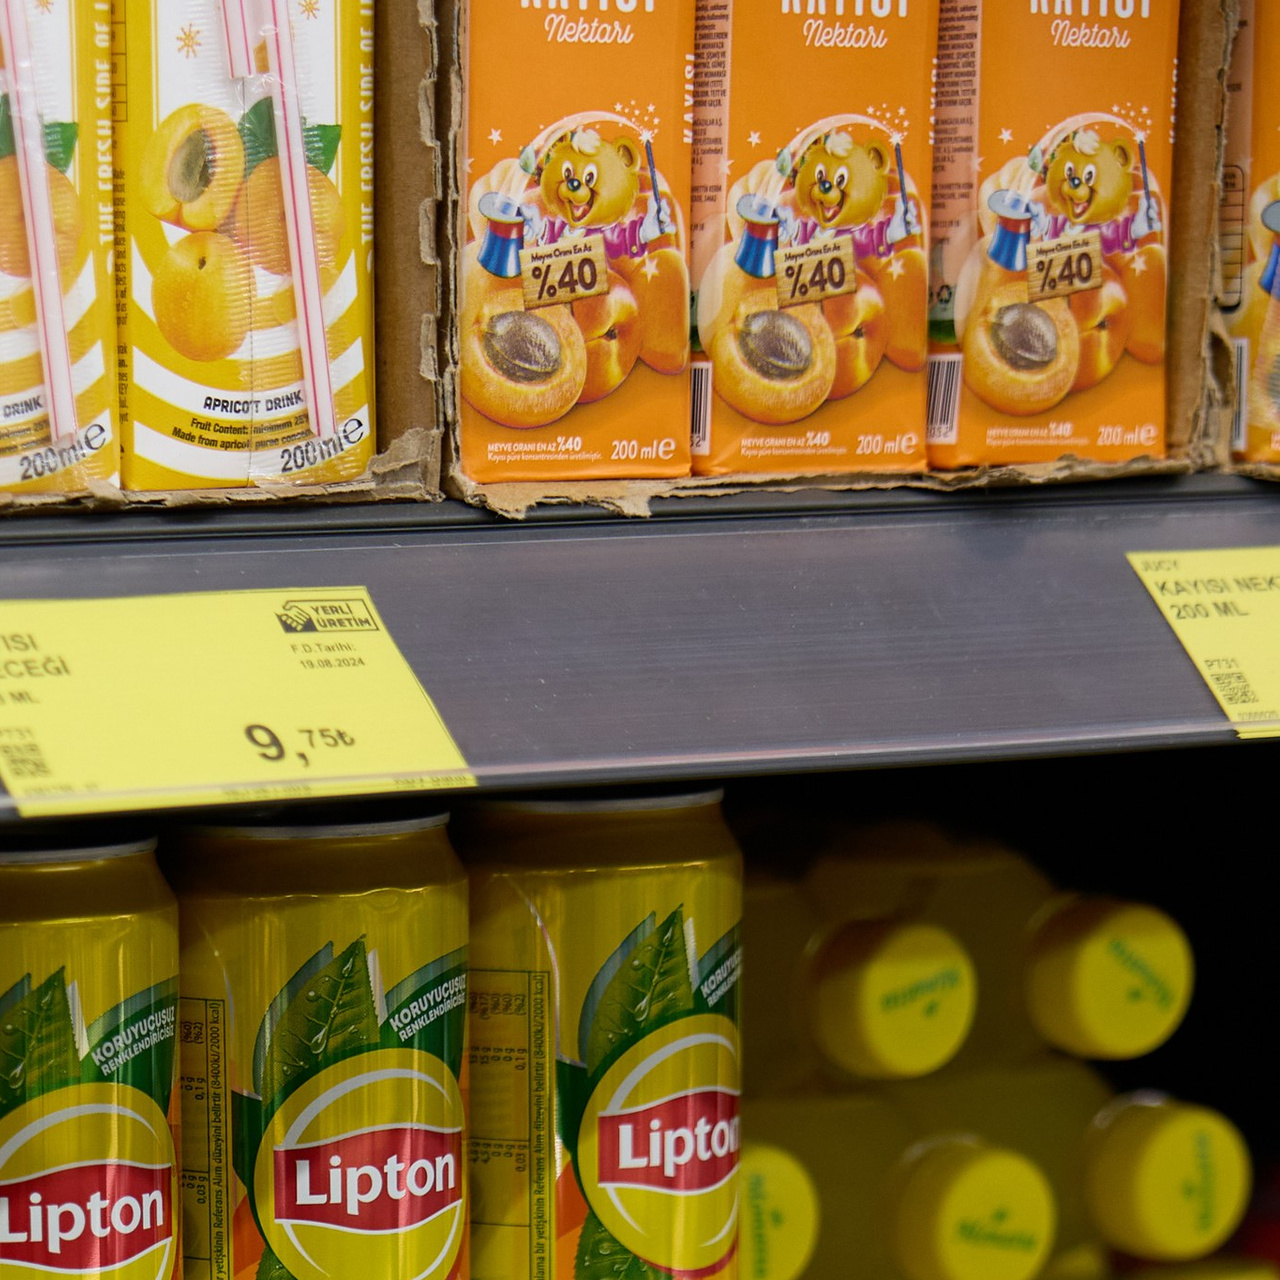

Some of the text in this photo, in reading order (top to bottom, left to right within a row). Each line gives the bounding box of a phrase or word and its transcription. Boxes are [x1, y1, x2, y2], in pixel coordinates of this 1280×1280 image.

[544, 14, 634, 45] Nektarı
[803, 18, 888, 49] Nektarı
[1051, 19, 1131, 49] Nektarı
[531, 257, 597, 300] %40
[785, 256, 846, 299] %40
[1036, 252, 1093, 293] %40
[3, 395, 46, 419] DRINK
[203, 389, 304, 414] APRICOT DRINK
[190, 417, 249, 436] Fruit Content:
[557, 437, 582, 452] %40
[610, 440, 637, 461] 200
[856, 435, 881, 455] 200
[1154, 578, 1232, 597] KAYISI
[309, 602, 354, 619] YERLİ
[316, 613, 374, 631] ÜRETİM
[1170, 600, 1251, 621] 200 ML
[300, 656, 366, 671] 19.08.2024
[388, 973, 467, 1033] KORUYUCUSUZ
[91, 1005, 176, 1067] KORUYUCUSUZ
[618, 1115, 741, 1178] Lipton
[295, 1153, 456, 1216] Lipton
